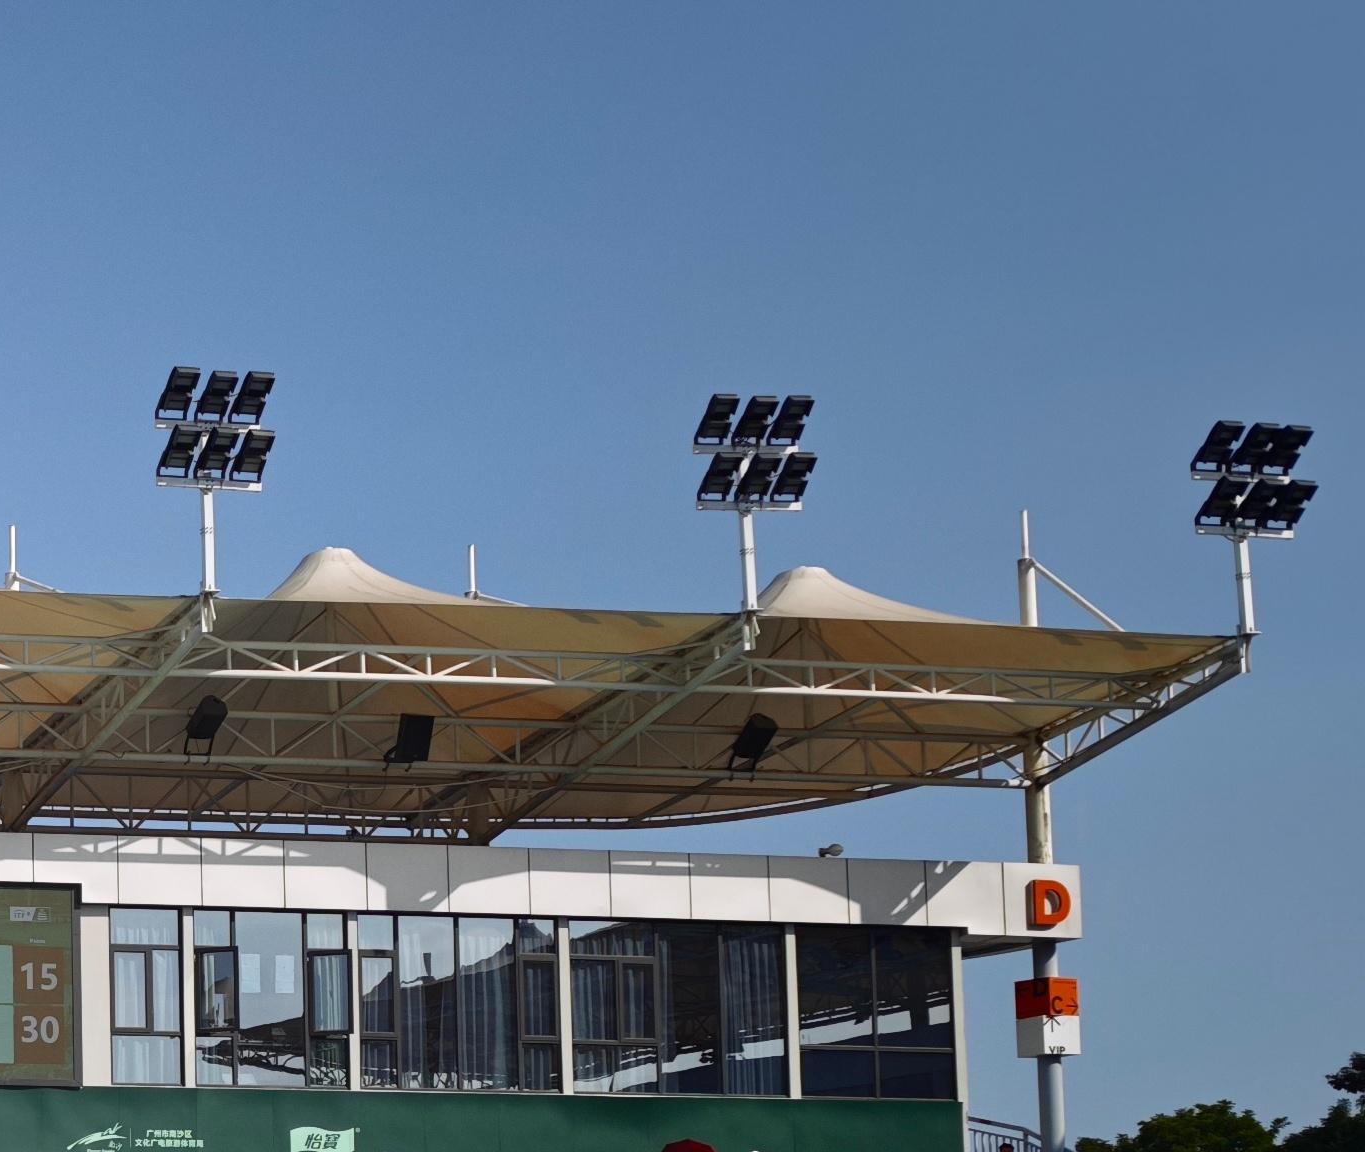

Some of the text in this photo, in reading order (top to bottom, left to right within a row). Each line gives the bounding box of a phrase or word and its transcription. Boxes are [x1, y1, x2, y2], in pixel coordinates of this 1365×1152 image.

[1033, 879, 1072, 927] D
[21, 962, 58, 991] 15
[1051, 996, 1063, 1015] C
[21, 1015, 60, 1044] 30
[1049, 1045, 1066, 1054] VIP
